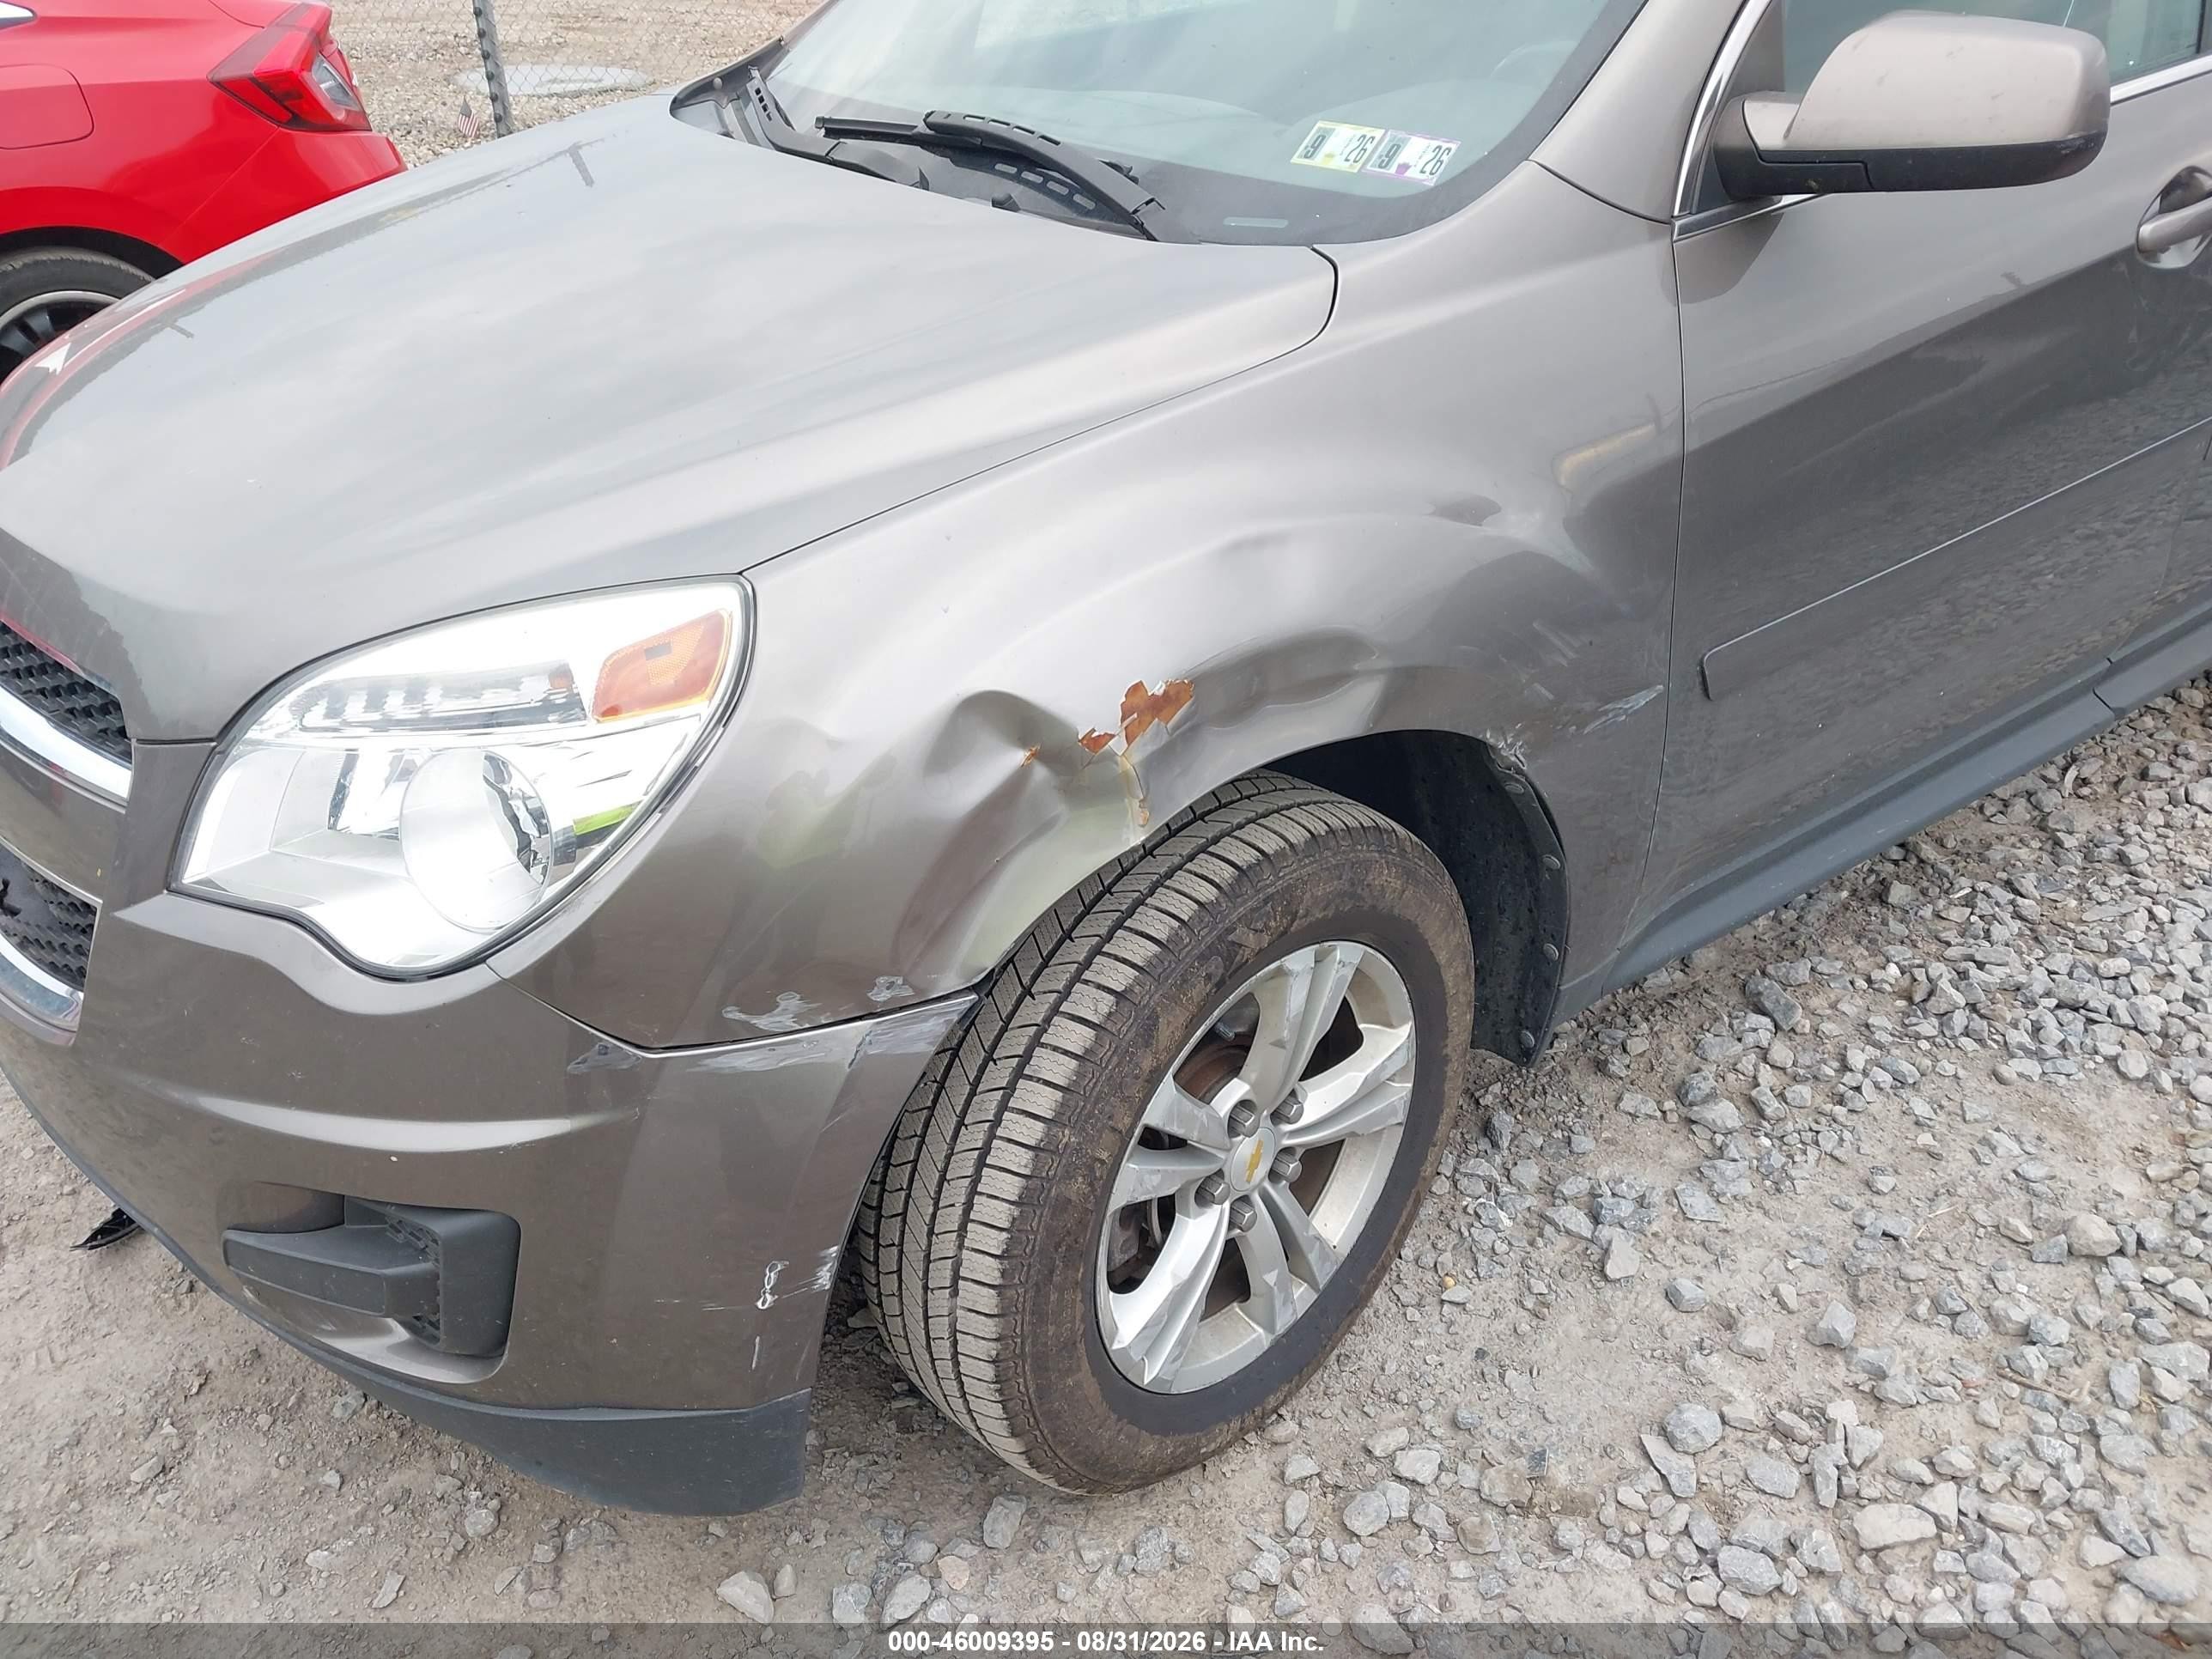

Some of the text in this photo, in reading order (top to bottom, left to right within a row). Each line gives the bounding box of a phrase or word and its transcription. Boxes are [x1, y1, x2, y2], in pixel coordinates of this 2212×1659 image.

[1304, 134, 1327, 160] 9
[1343, 134, 1376, 164] 26
[1377, 143, 1401, 169] 9
[1419, 144, 1453, 176] 26
